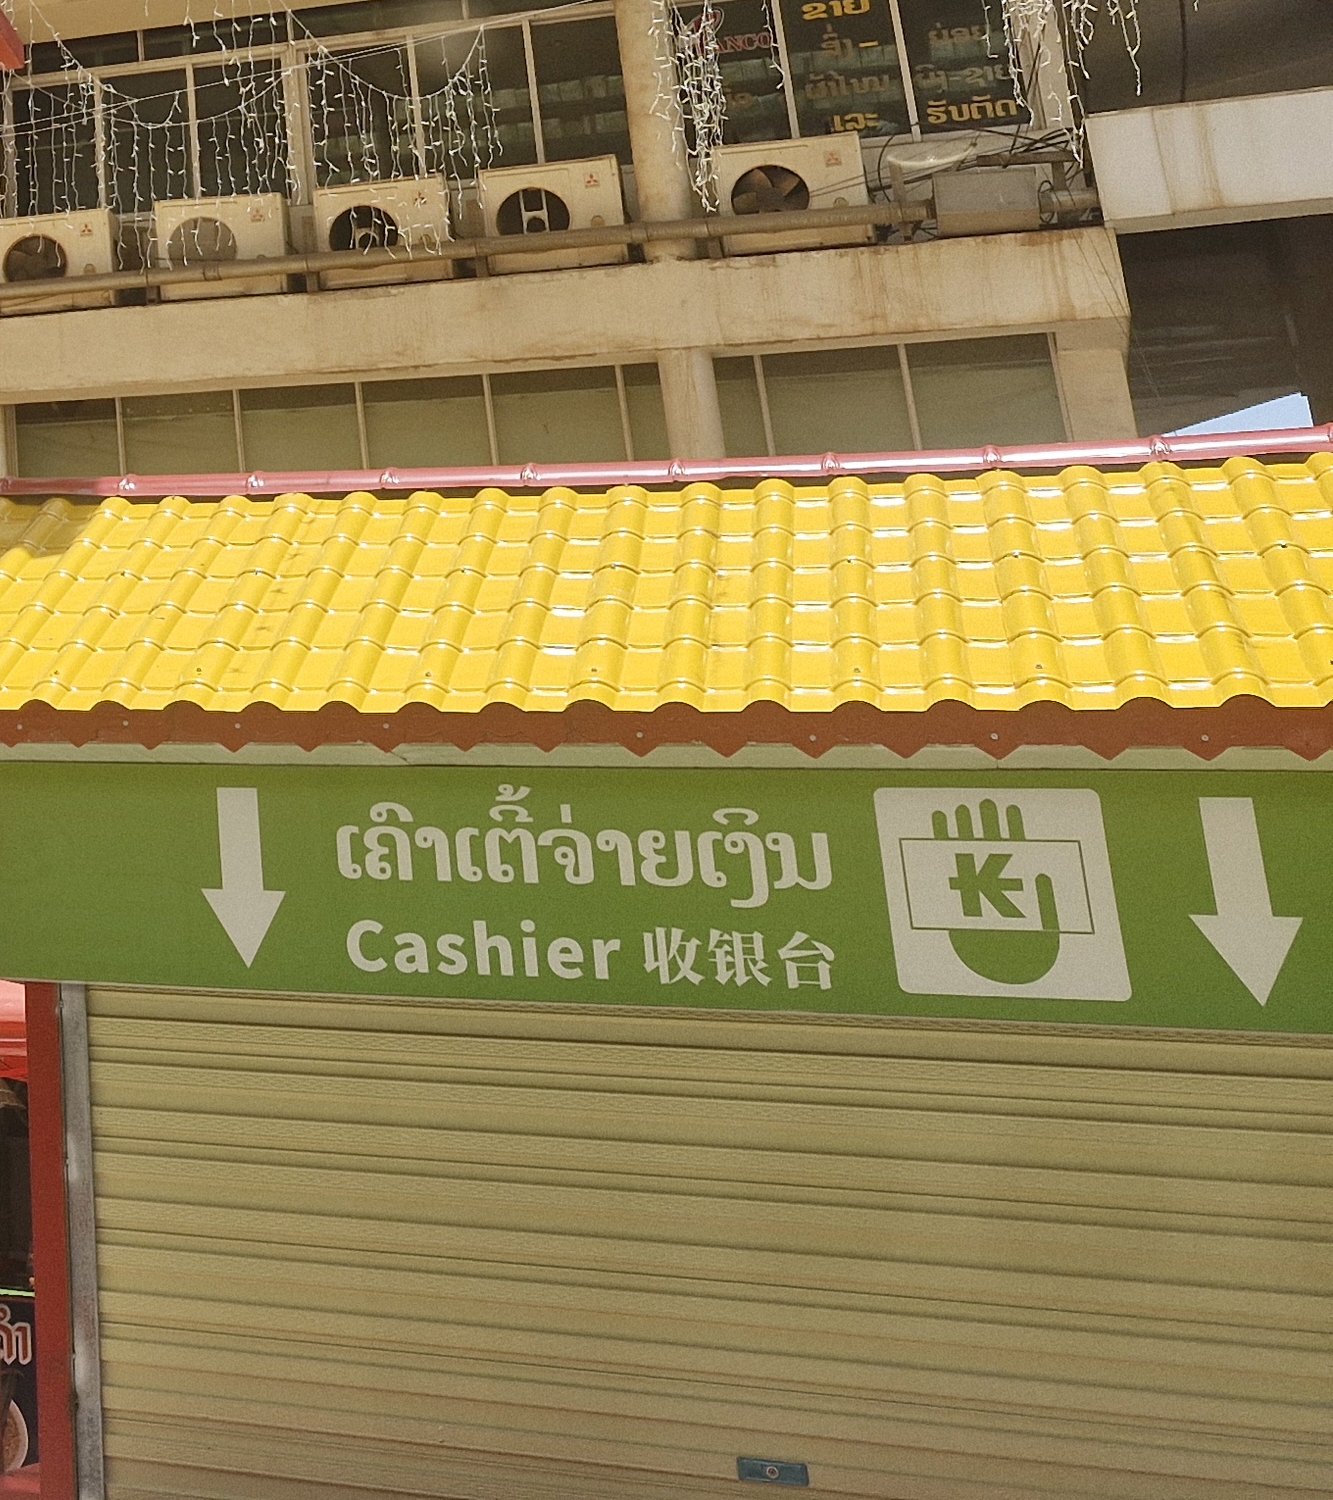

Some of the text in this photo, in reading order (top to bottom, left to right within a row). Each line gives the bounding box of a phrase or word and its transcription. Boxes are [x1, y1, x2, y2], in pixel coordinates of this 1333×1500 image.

[927, 95, 1018, 124] ຮັບຕັດ
[346, 919, 834, 990] Cashier 收银台
